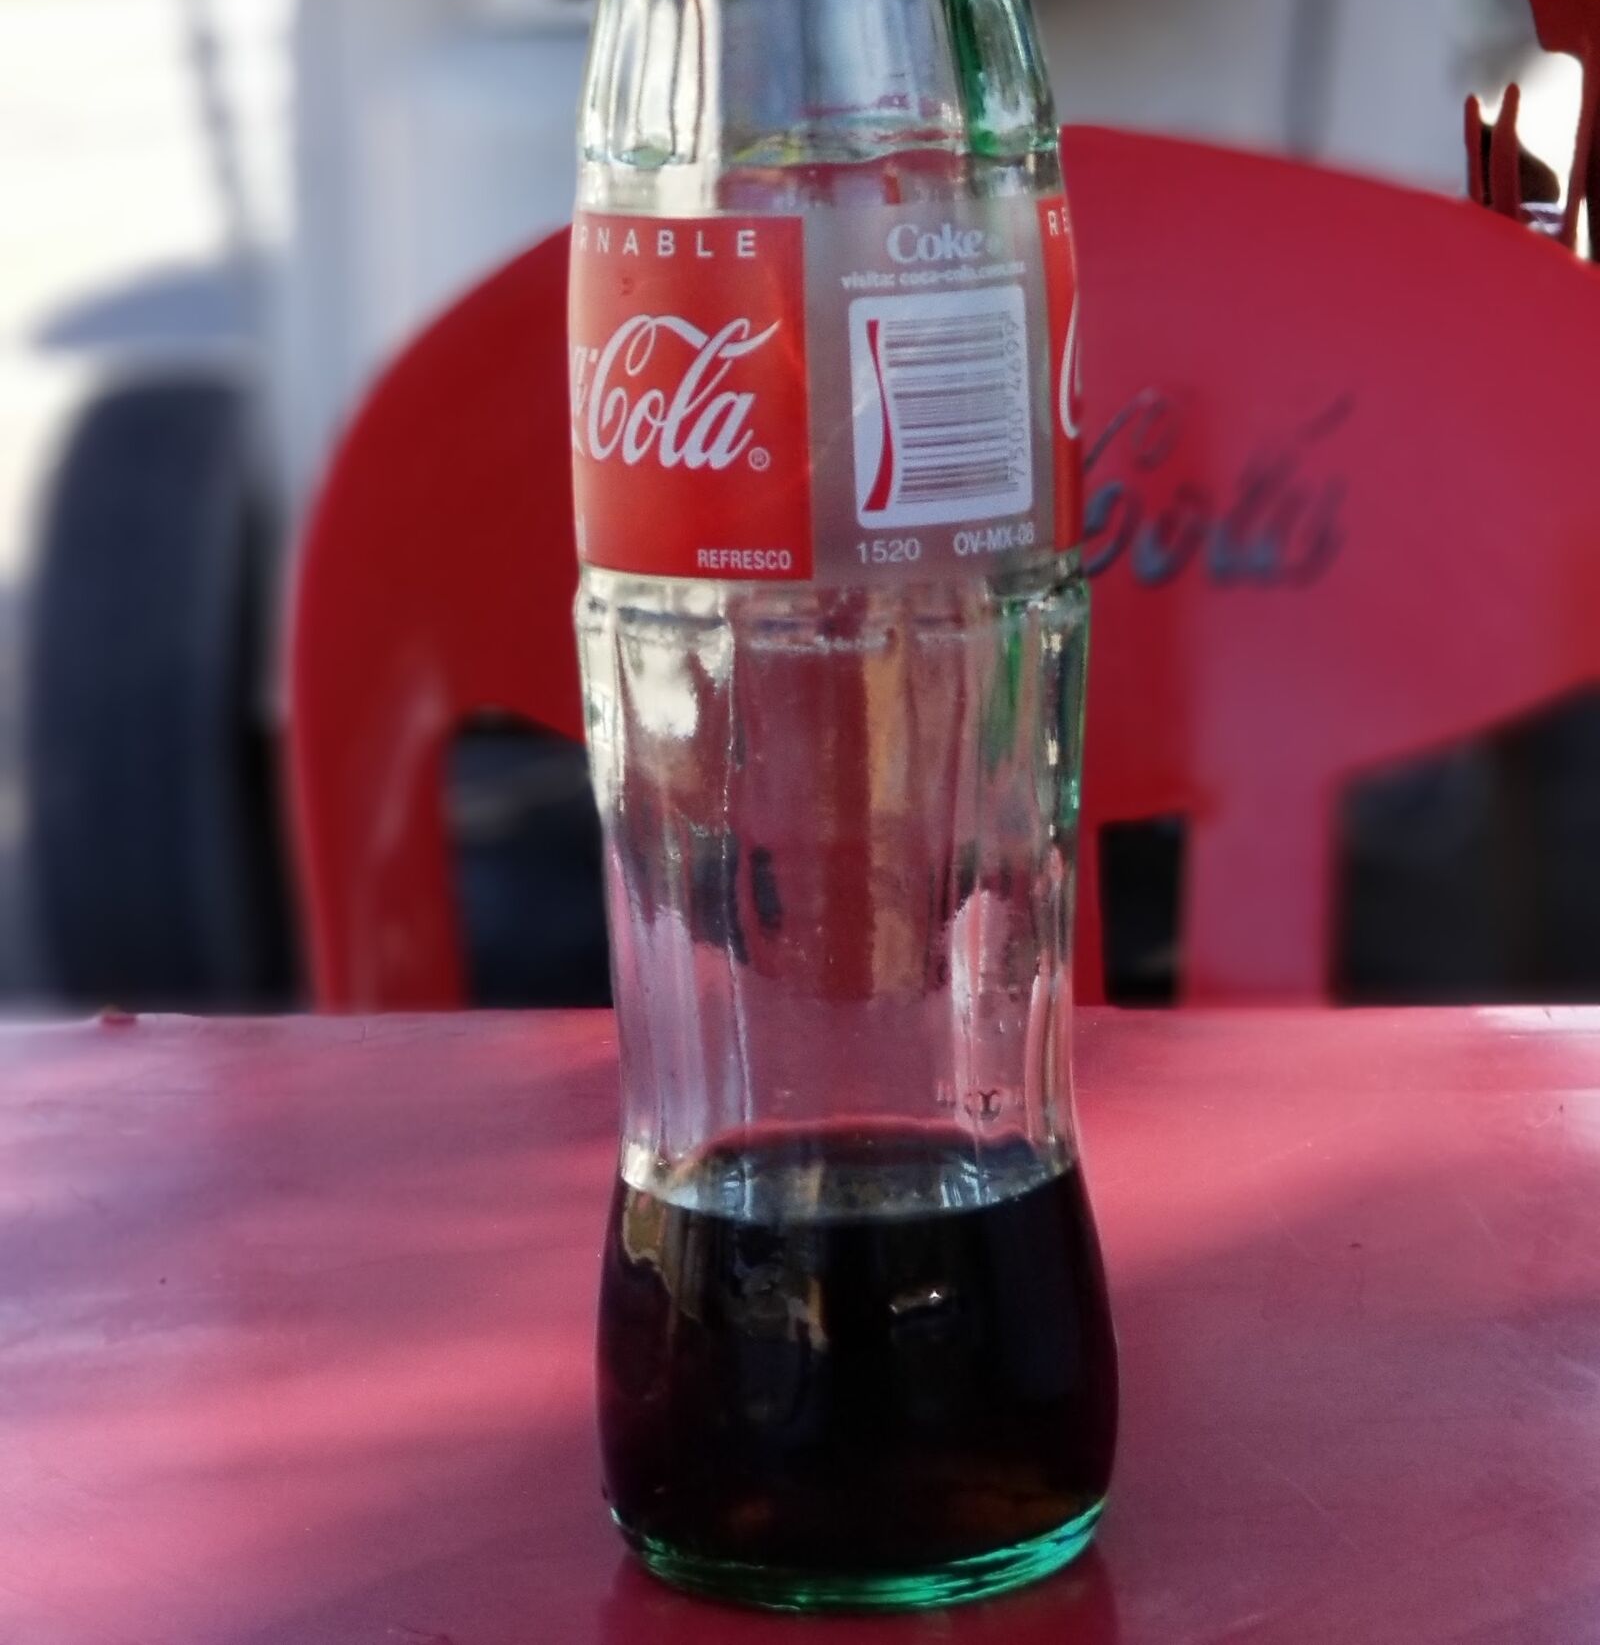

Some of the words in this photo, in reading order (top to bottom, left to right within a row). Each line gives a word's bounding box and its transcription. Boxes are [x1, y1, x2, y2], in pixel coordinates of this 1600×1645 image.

[886, 223, 984, 264] Coke
[697, 549, 792, 570] REFRESCO
[857, 538, 921, 564] 1520
